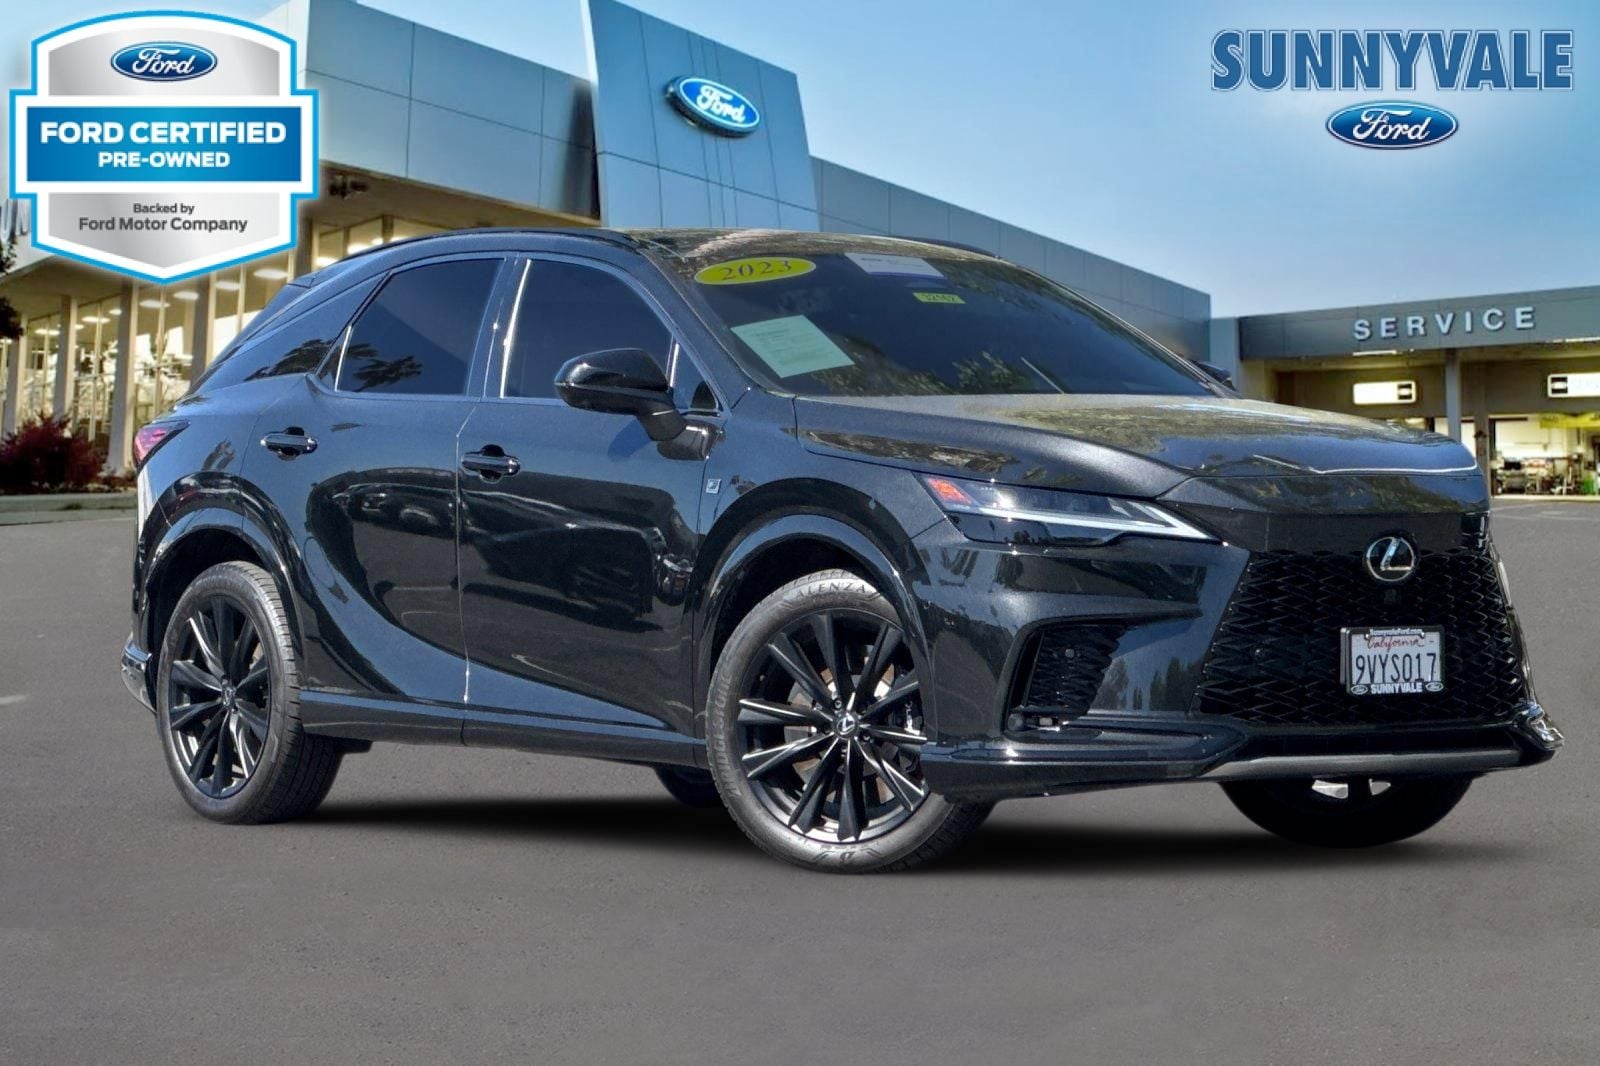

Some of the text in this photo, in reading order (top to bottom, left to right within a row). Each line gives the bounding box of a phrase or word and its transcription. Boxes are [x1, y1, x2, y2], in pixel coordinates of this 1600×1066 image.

[696, 85, 746, 122] Ford
[719, 260, 792, 281] 2023
[1353, 306, 1535, 341] SERVICE
[796, 581, 866, 600] ALENZA
[1367, 635, 1425, 653] California
[1355, 652, 1437, 685] 9VYS017
[1370, 681, 1423, 695] SUNNYVALE
